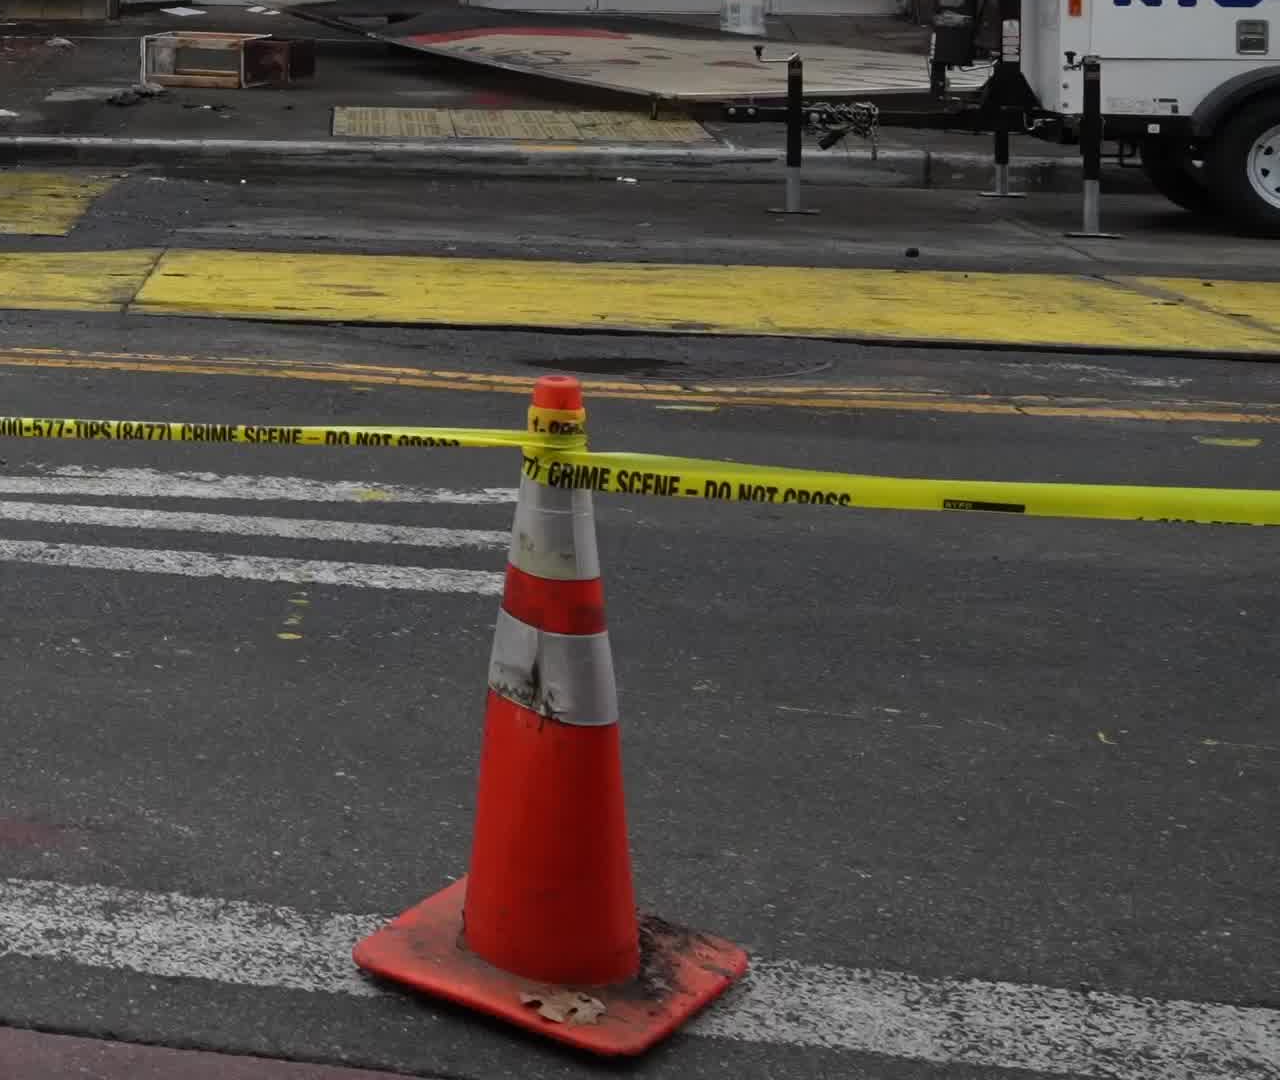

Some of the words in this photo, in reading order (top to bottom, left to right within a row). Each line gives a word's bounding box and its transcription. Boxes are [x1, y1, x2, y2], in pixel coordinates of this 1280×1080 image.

[244, 426, 302, 444] SCENE
[548, 461, 611, 491] CRIME
[616, 469, 681, 496] SCENE
